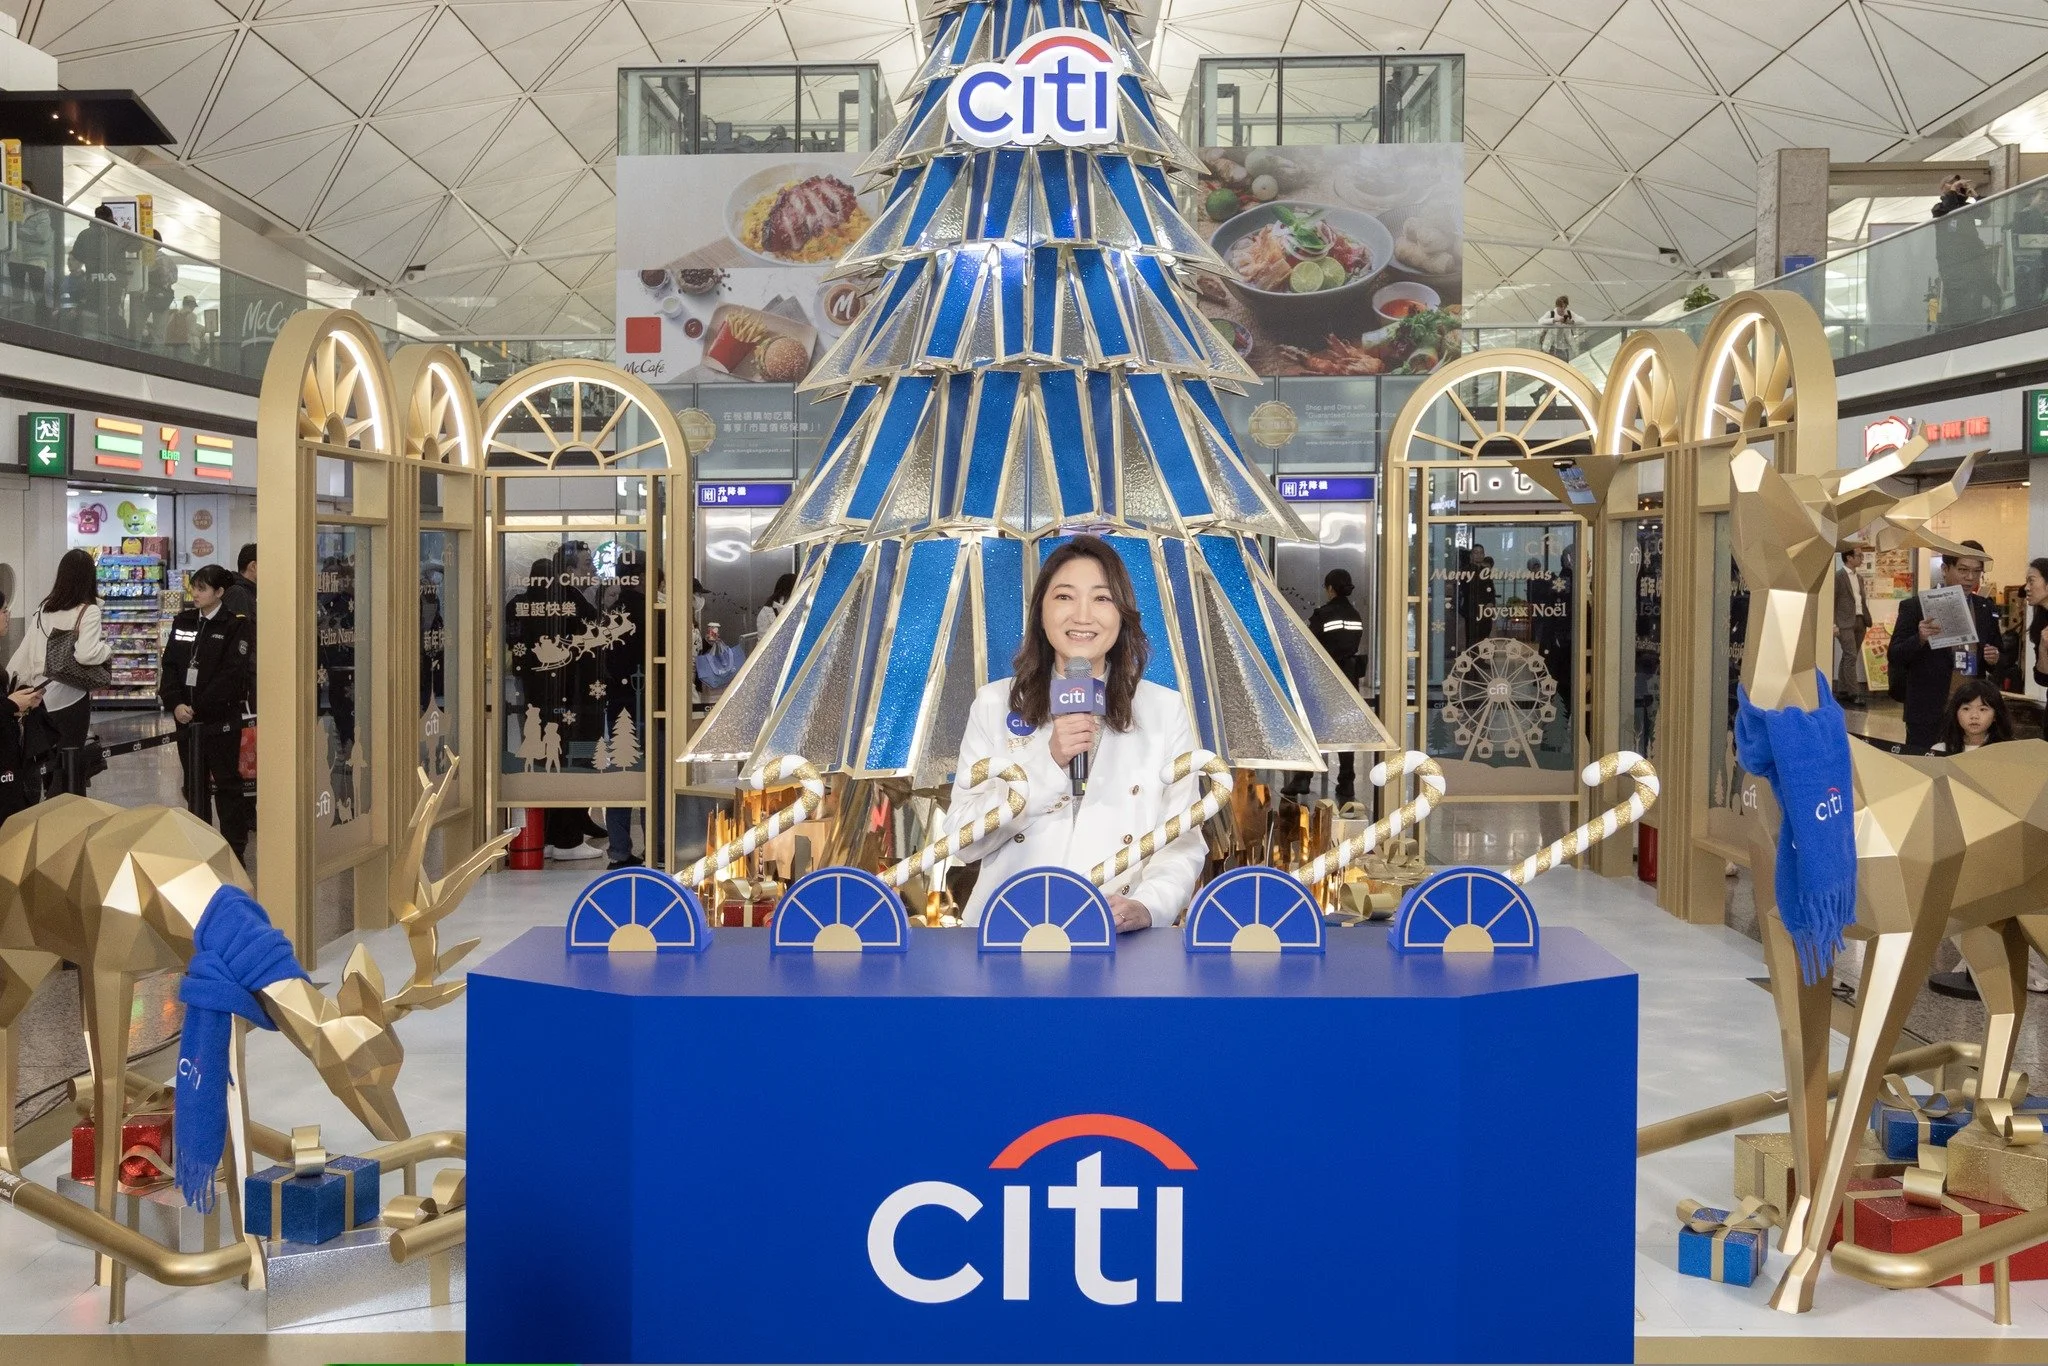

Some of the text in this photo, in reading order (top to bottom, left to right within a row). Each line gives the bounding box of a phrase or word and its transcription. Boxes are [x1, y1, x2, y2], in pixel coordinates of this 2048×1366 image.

[958, 36, 1113, 134] citi
[623, 359, 665, 377] McCafé
[718, 486, 747, 496] 升降機
[1299, 481, 1328, 490] 升降機
[559, 572, 640, 586] Christmas
[1430, 567, 1552, 583] Merry Christmas
[515, 601, 577, 617] 聖誕快樂
[1476, 602, 1567, 621] Joyeux Noël
[1059, 687, 1085, 705] citi
[1489, 682, 1508, 695] citi
[427, 710, 440, 736] citi
[1011, 718, 1029, 728] cit
[0, 770, 14, 783] citi
[1815, 787, 1843, 821] citi
[866, 1113, 1199, 1305] citi
